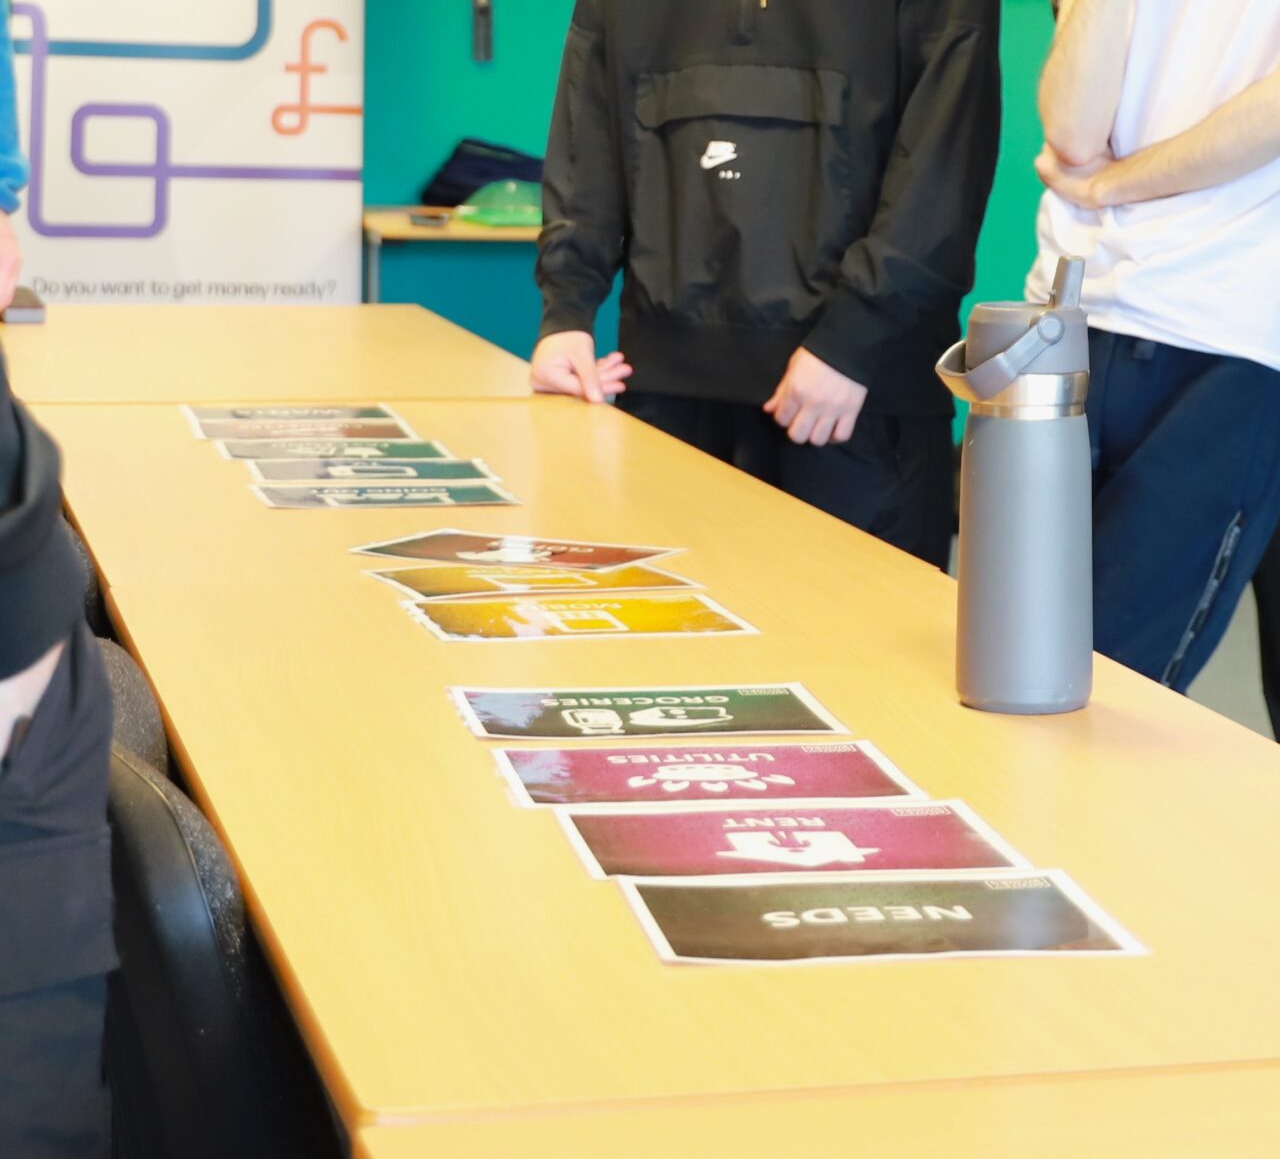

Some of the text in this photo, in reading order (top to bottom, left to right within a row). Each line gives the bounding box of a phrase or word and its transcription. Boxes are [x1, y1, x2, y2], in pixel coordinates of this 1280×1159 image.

[32, 276, 337, 302] Do you want to get money ready?
[540, 695, 730, 707] GROCERIES
[606, 752, 776, 765] UTILITIES
[721, 815, 827, 830] RENT
[760, 903, 975, 930] NEEDS
